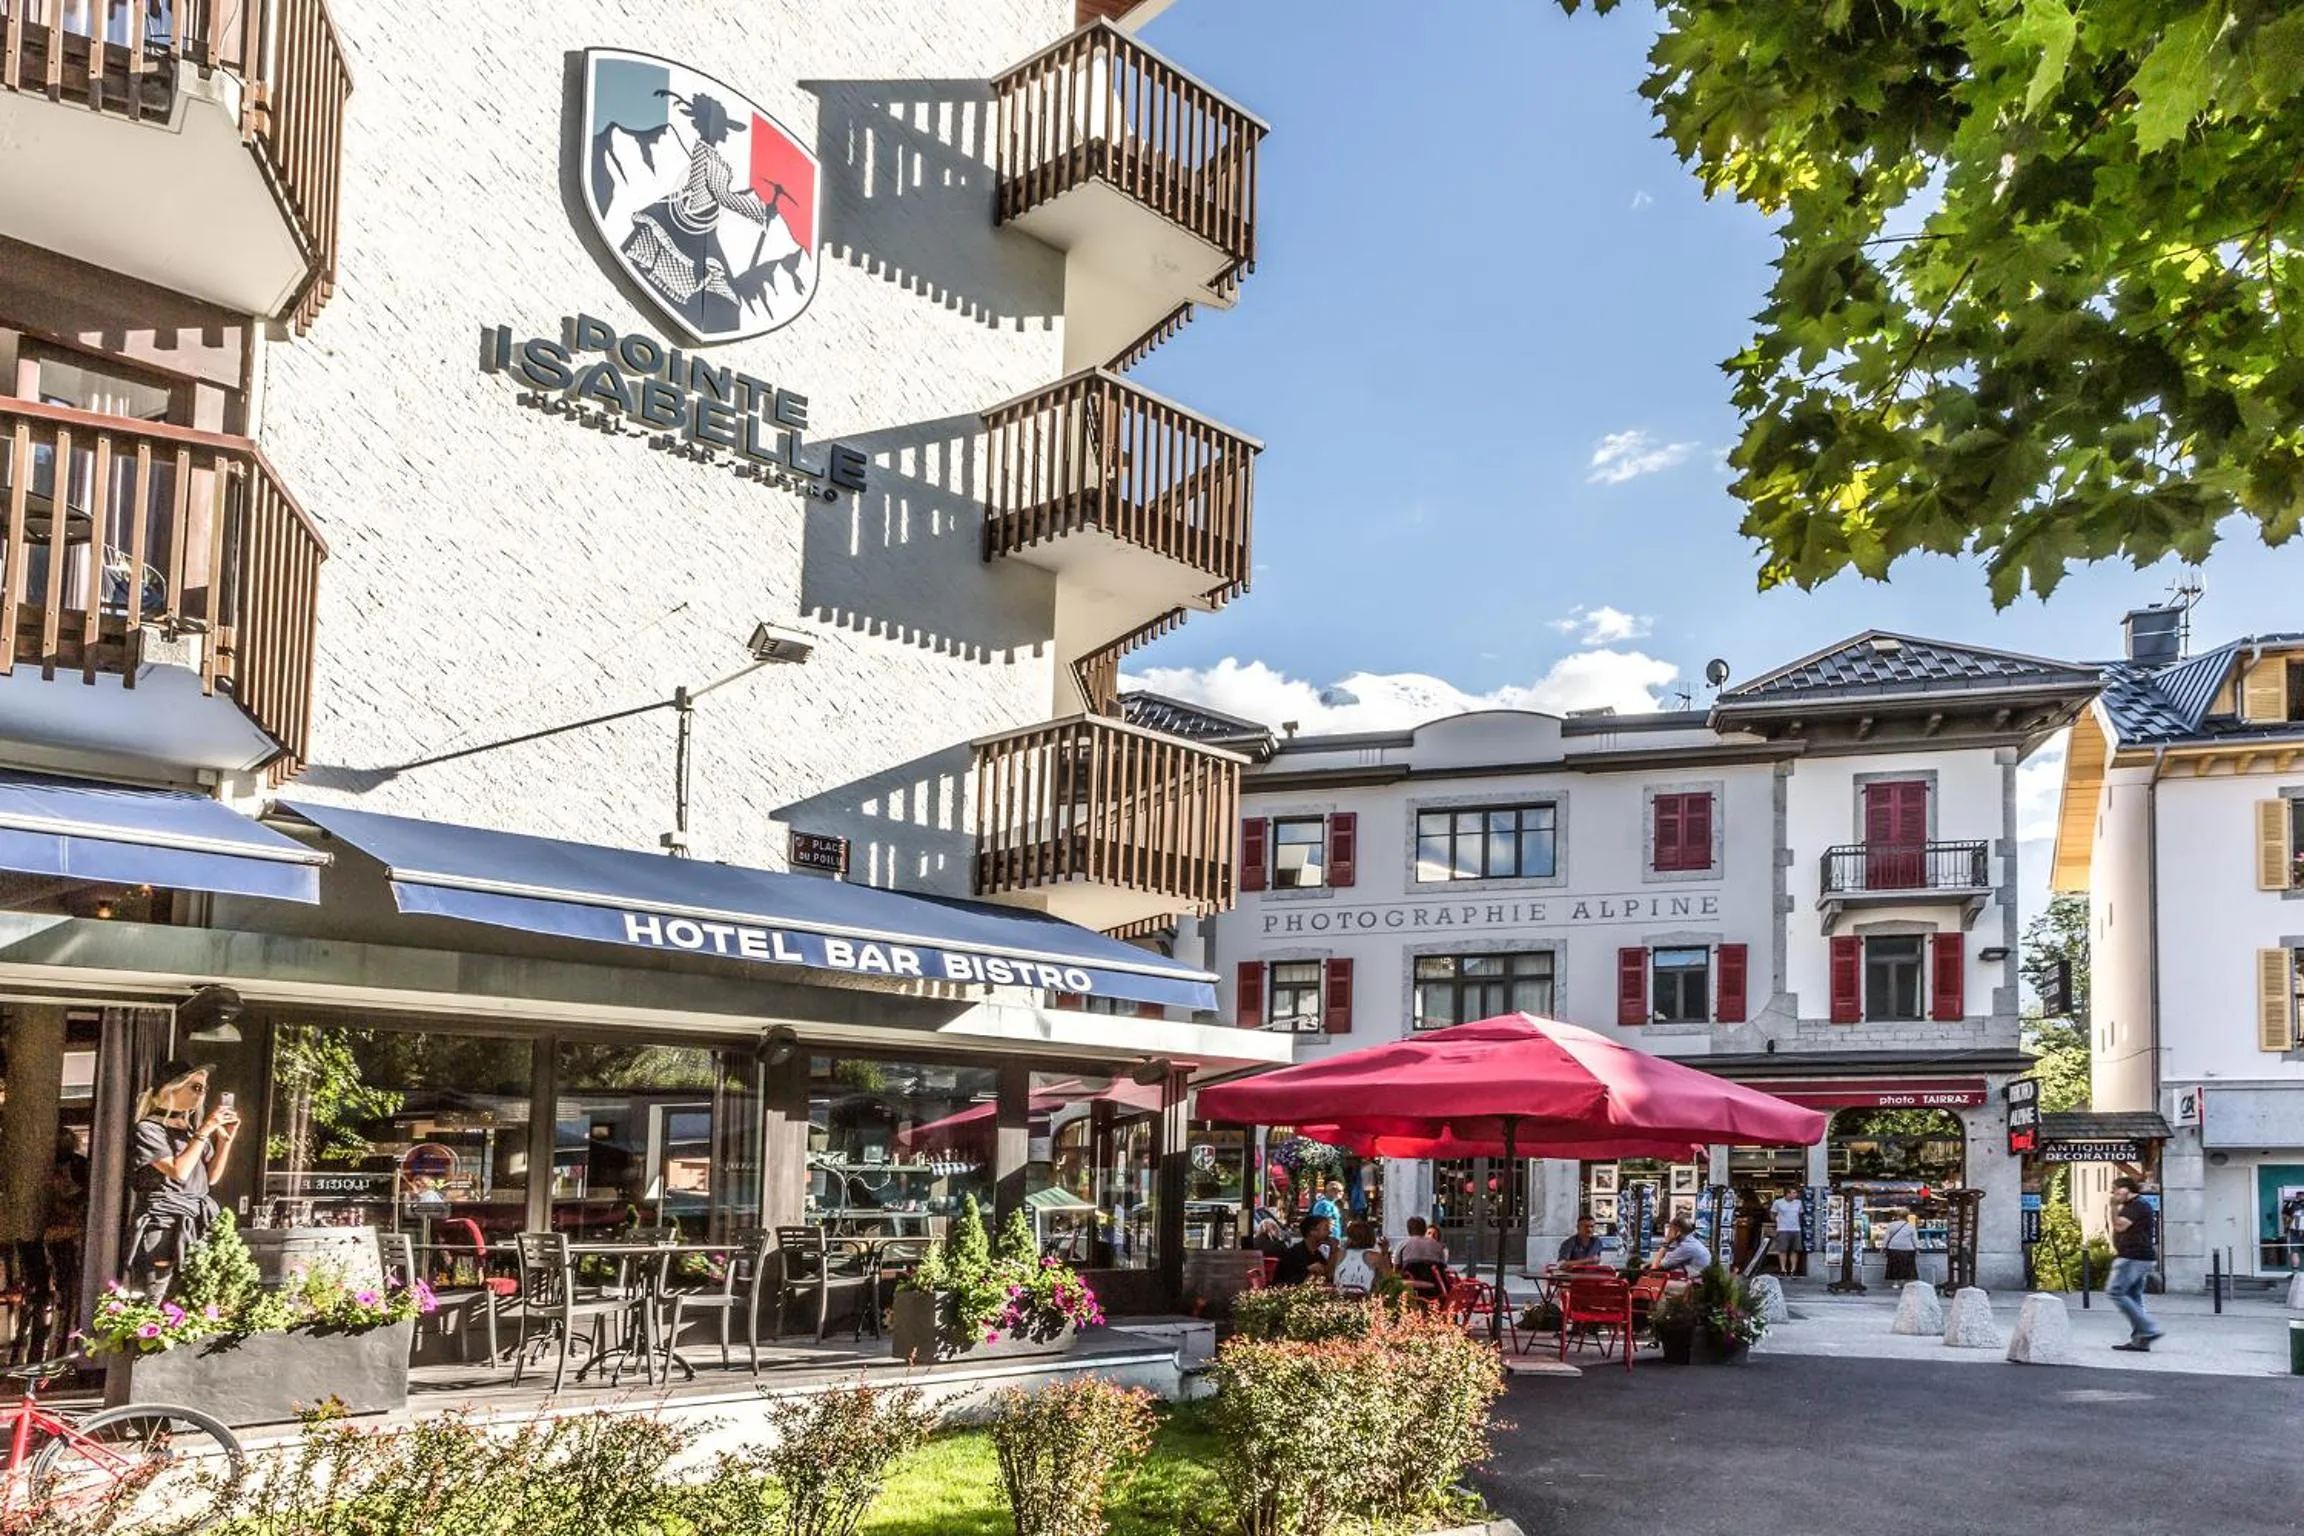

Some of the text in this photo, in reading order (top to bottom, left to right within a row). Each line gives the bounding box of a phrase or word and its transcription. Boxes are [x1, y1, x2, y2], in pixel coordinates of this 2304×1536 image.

[495, 324, 868, 493] ISABELLE
[576, 312, 809, 430] POINTE
[530, 388, 628, 433] HOTEL
[662, 433, 716, 463] BAR
[1262, 896, 1719, 933] PHOTOGRAPHIE ALPINE
[622, 913, 1094, 994] HOTEL BAR BISTRO
[1879, 1094, 1970, 1106] photo TAIRRAZ
[2045, 1152, 2137, 1161] DECORATION
